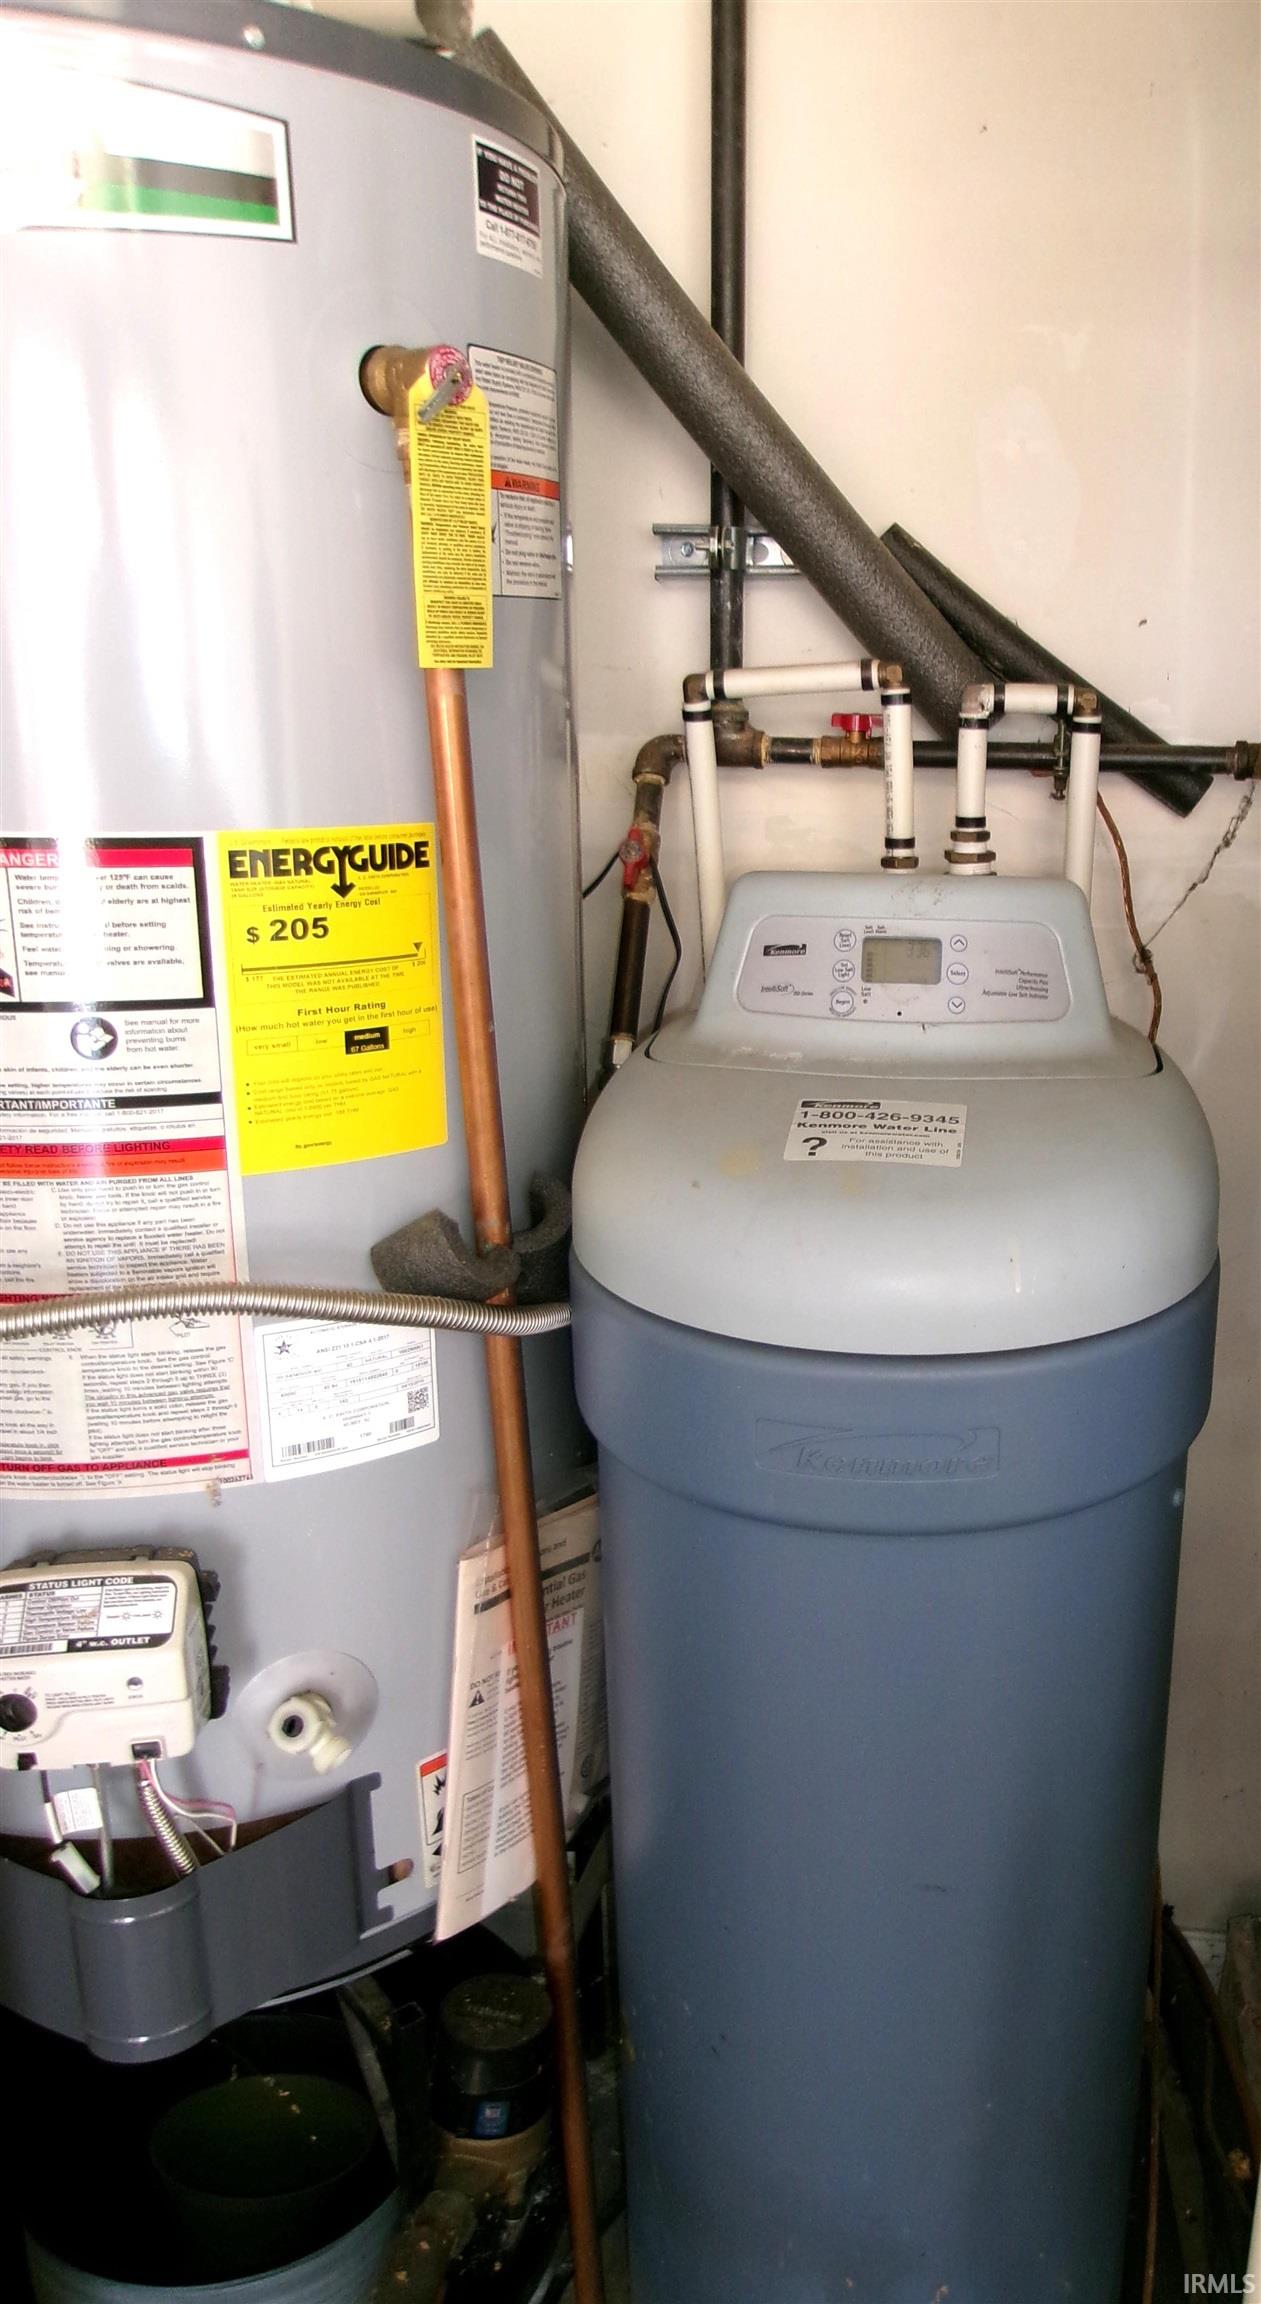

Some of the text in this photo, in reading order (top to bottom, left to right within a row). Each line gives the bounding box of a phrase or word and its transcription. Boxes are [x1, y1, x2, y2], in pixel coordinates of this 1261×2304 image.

[228, 841, 429, 879] ENERGYGUIDE
[263, 903, 304, 912] Estimated
[307, 902, 332, 911] Yearly
[336, 900, 362, 909] Energy
[247, 917, 329, 944] $ 205
[337, 976, 370, 984] AVAILABLE
[298, 1001, 386, 1016] First Hour Rating
[260, 1023, 283, 1031] much
[302, 1019, 324, 1027] water
[327, 1018, 342, 1026] you
[344, 1015, 358, 1024] get
[380, 1011, 395, 1019] first
[424, 1005, 438, 1013] use)
[354, 1032, 380, 1041] medium
[361, 1043, 384, 1052] Gallons
[801, 1111, 960, 1124] 1-800-426-9345
[25, 1146, 58, 1154] READ
[114, 1141, 170, 1153] LIGHTING
[85, 1464, 99, 1472] TO
[102, 1460, 167, 1471] APPLIANCE
[29, 1577, 134, 1590] STATUS LIGHT CODE
[568, 1571, 586, 1584] Gas
[553, 1587, 585, 1608] Heater
[111, 1636, 151, 1645] OUTLET
